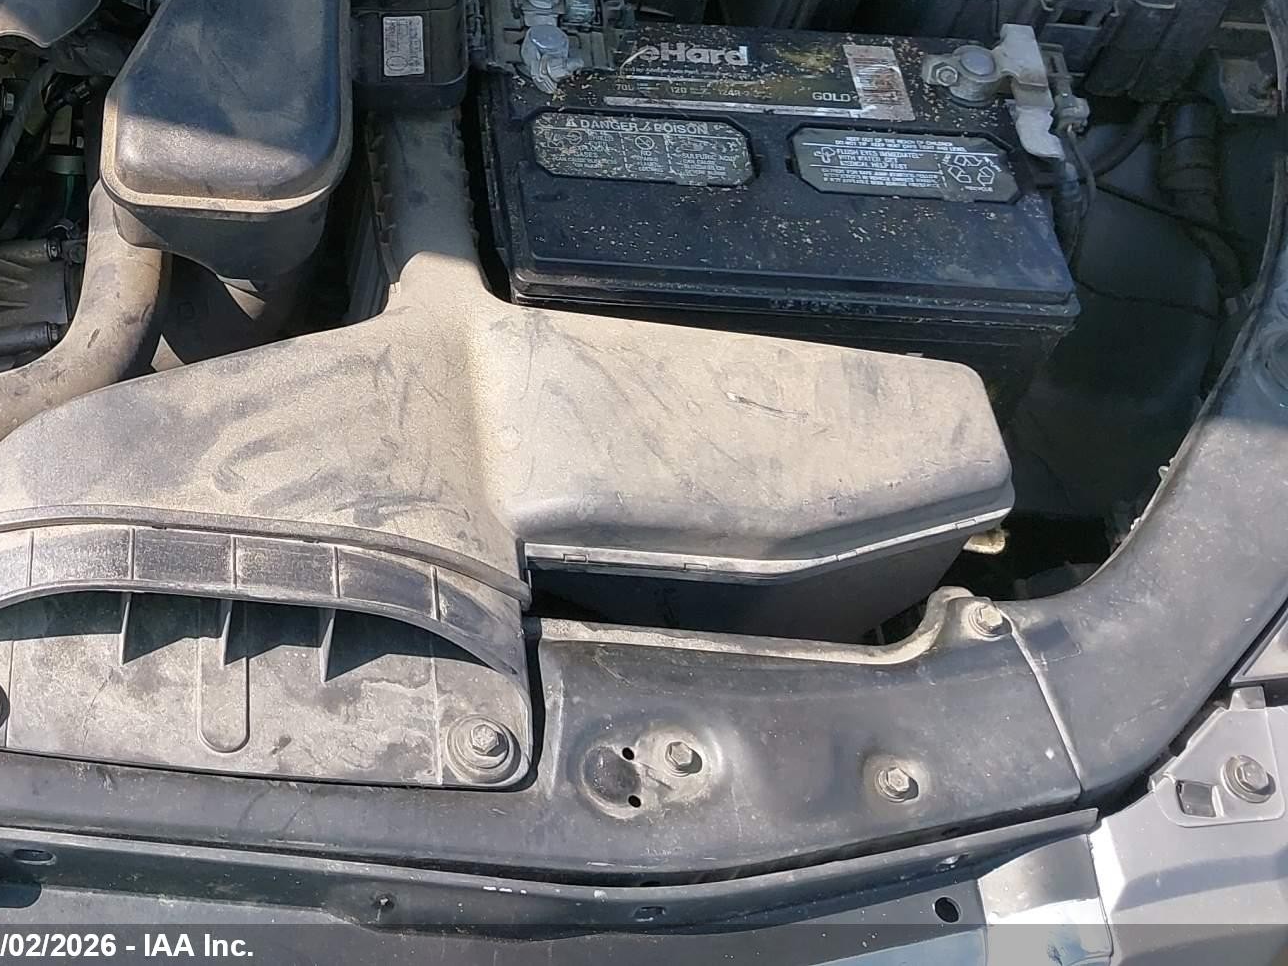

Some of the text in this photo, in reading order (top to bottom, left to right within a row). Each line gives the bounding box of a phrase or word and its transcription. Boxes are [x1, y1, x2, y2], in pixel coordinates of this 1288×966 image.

[812, 91, 851, 103] GOLD
[580, 119, 639, 132] DANGER
[653, 122, 708, 134] POISON
